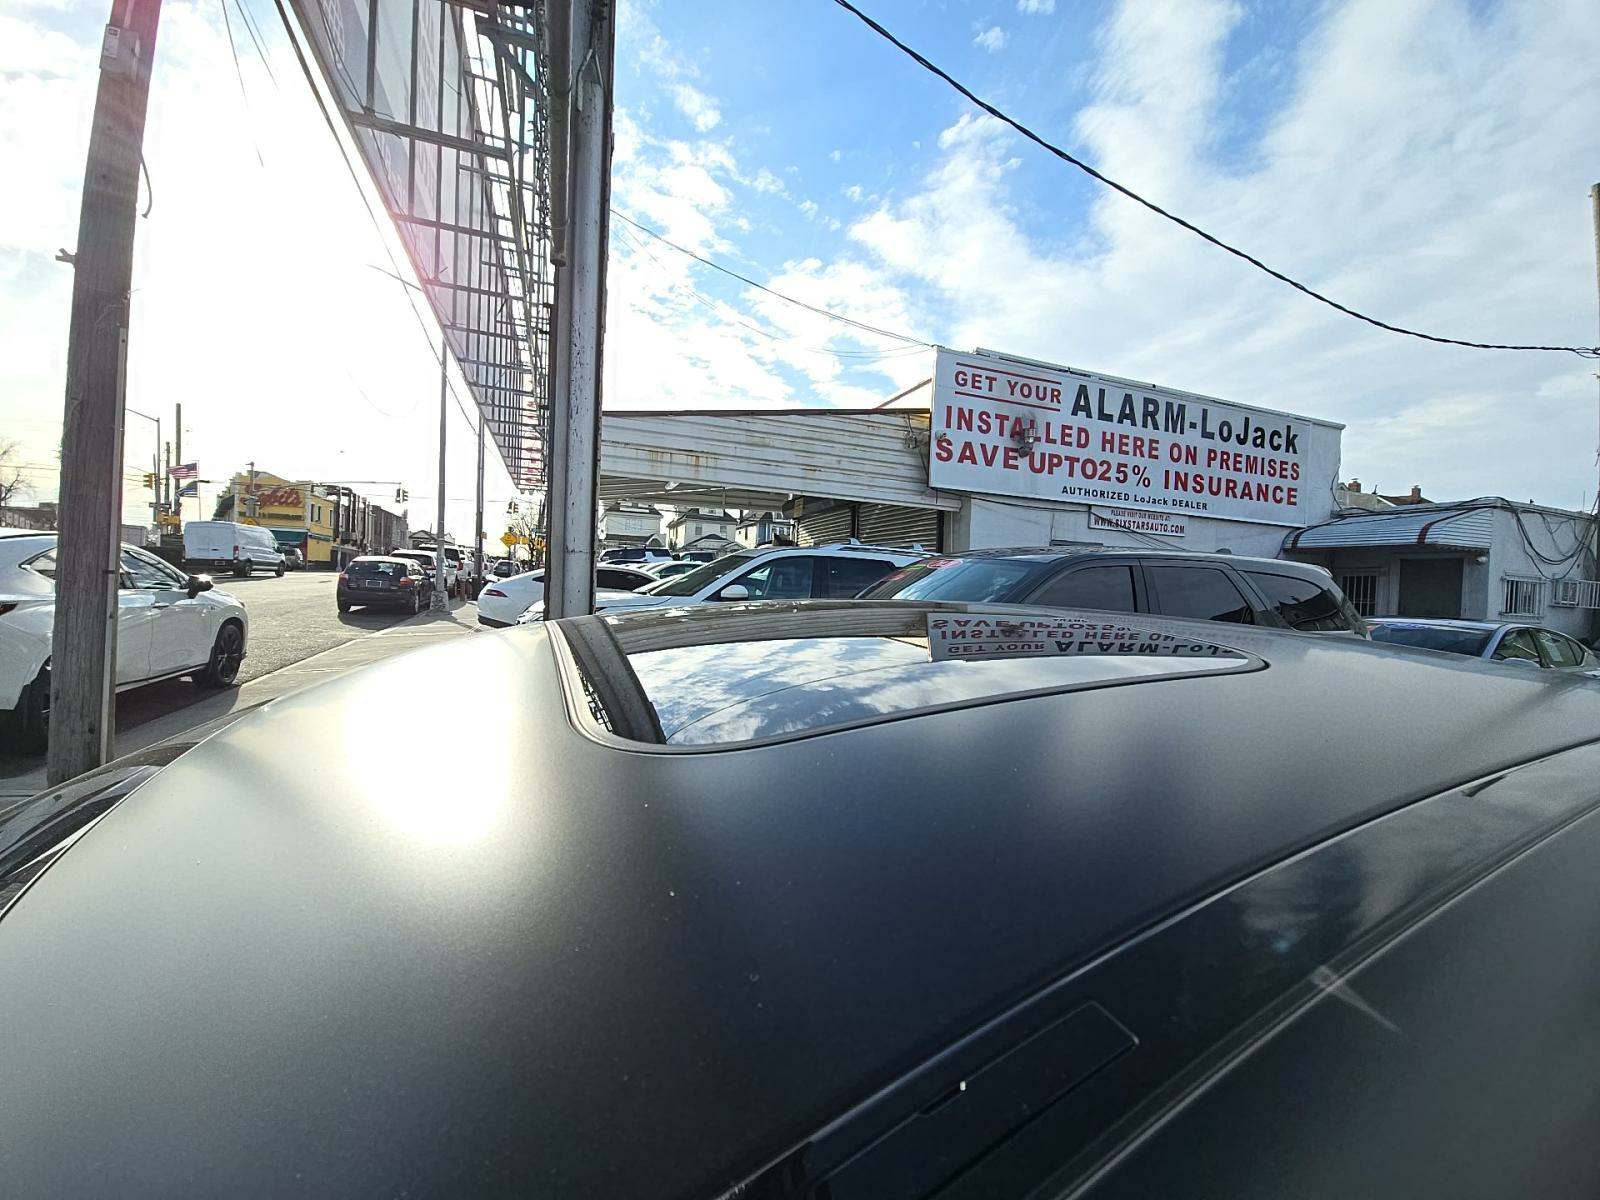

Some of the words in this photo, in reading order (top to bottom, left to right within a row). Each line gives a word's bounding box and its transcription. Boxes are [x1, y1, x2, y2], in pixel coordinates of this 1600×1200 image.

[954, 370, 997, 392] GET
[1007, 379, 1061, 404] YOUR
[1071, 384, 1299, 454] ALARM-LoJack
[935, 438, 1019, 470] SAVE
[1163, 469, 1298, 506] INSURANCE
[1101, 431, 1160, 460] HERE
[1169, 442, 1197, 465] ON
[1207, 448, 1300, 481] PREMISES
[1061, 485, 1130, 501] AUTHORIZED
[1134, 494, 1168, 506] LoJack
[1172, 499, 1208, 511] DEALER
